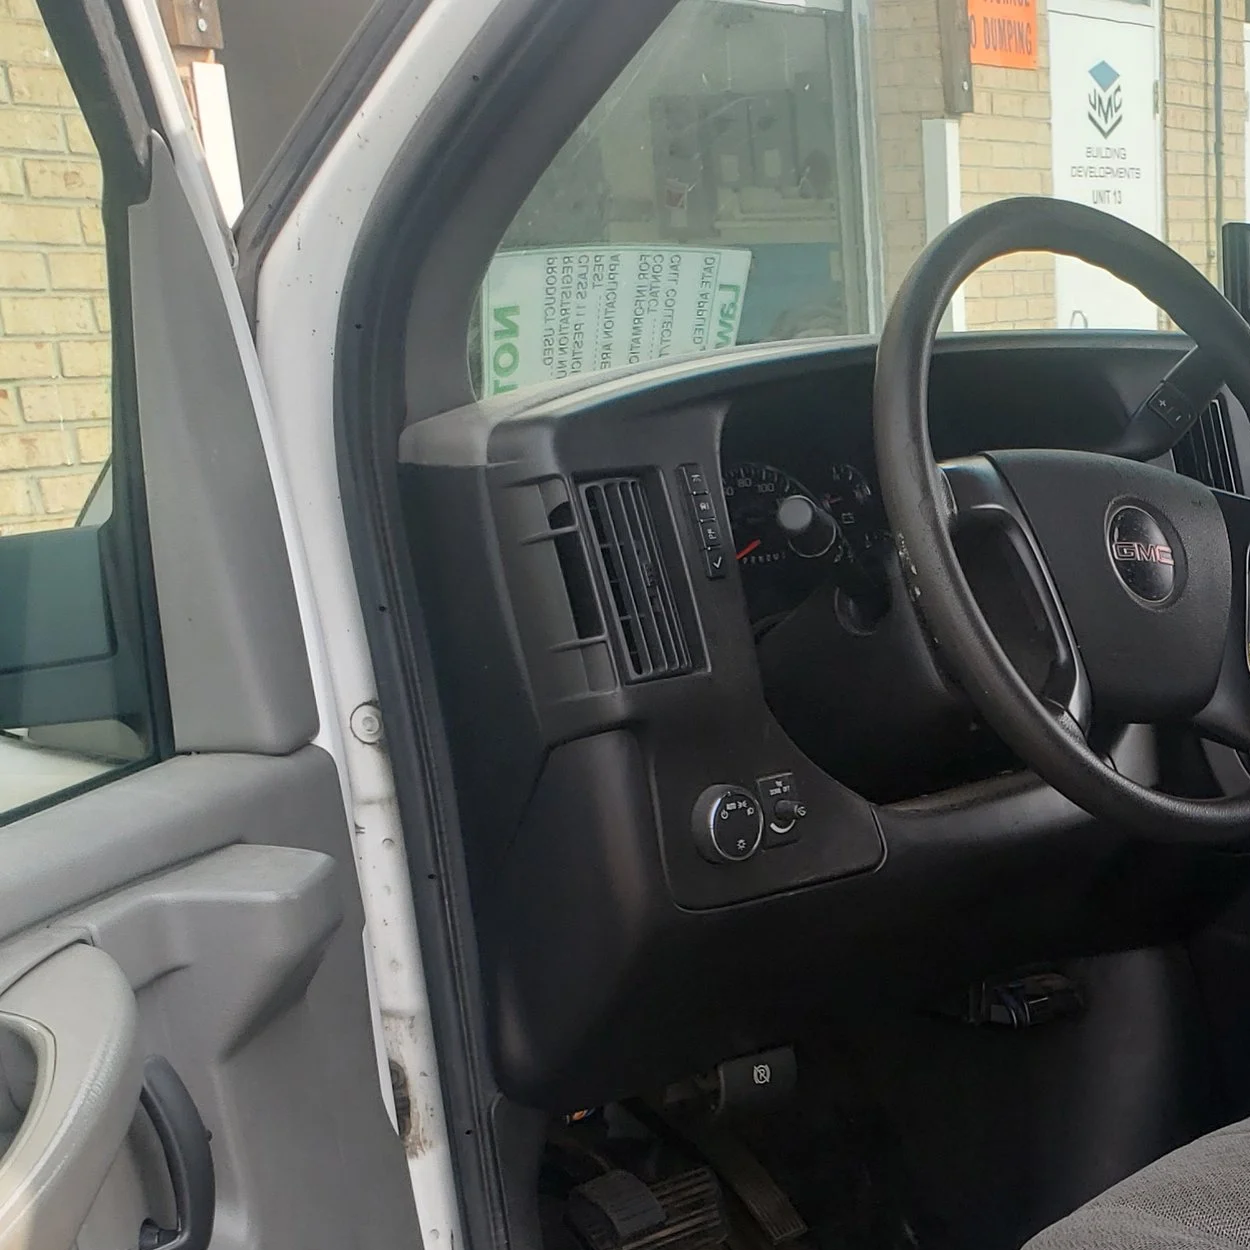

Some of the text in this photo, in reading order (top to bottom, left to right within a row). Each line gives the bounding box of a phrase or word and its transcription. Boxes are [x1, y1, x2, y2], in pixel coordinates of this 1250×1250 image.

[983, 16, 1032, 56] DUMPING
[1086, 146, 1127, 160] BUILDING
[1070, 165, 1141, 179] DEVELOPMENTS
[1092, 190, 1122, 204] UNIT 13
[1112, 541, 1175, 566] GMC
